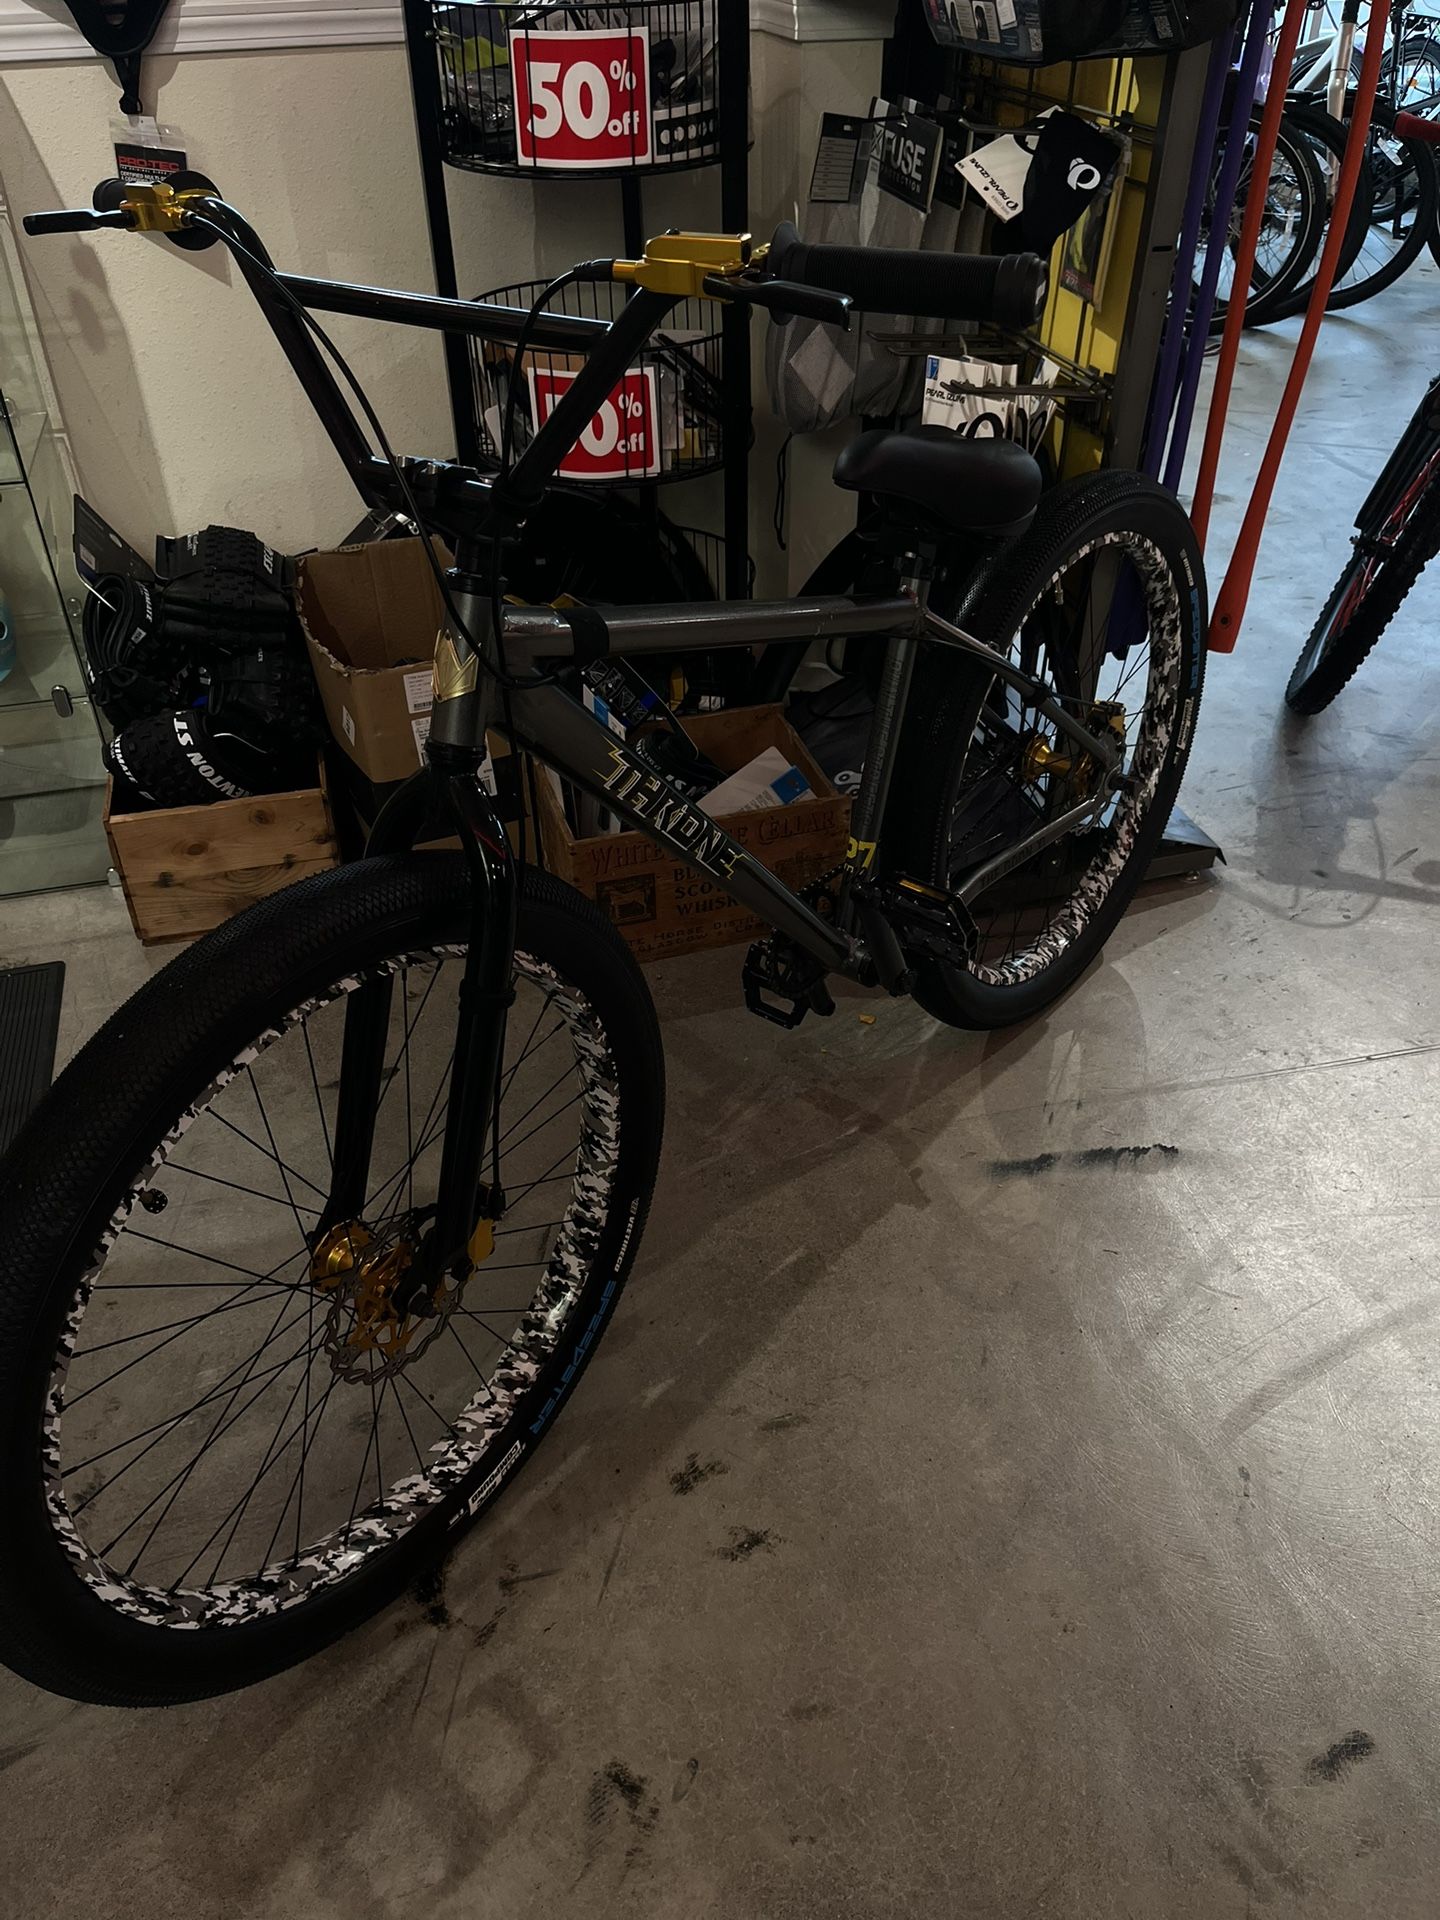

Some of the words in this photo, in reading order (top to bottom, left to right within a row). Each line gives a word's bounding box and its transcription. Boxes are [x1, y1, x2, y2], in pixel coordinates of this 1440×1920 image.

[607, 110, 640, 137] off
[884, 129, 926, 182] FUSE
[926, 387, 945, 400] PEARL
[617, 431, 645, 454] off
[591, 842, 665, 876] WHITE
[676, 895, 739, 917] WHISK
[529, 1279, 617, 1436] SPEEDSTER
